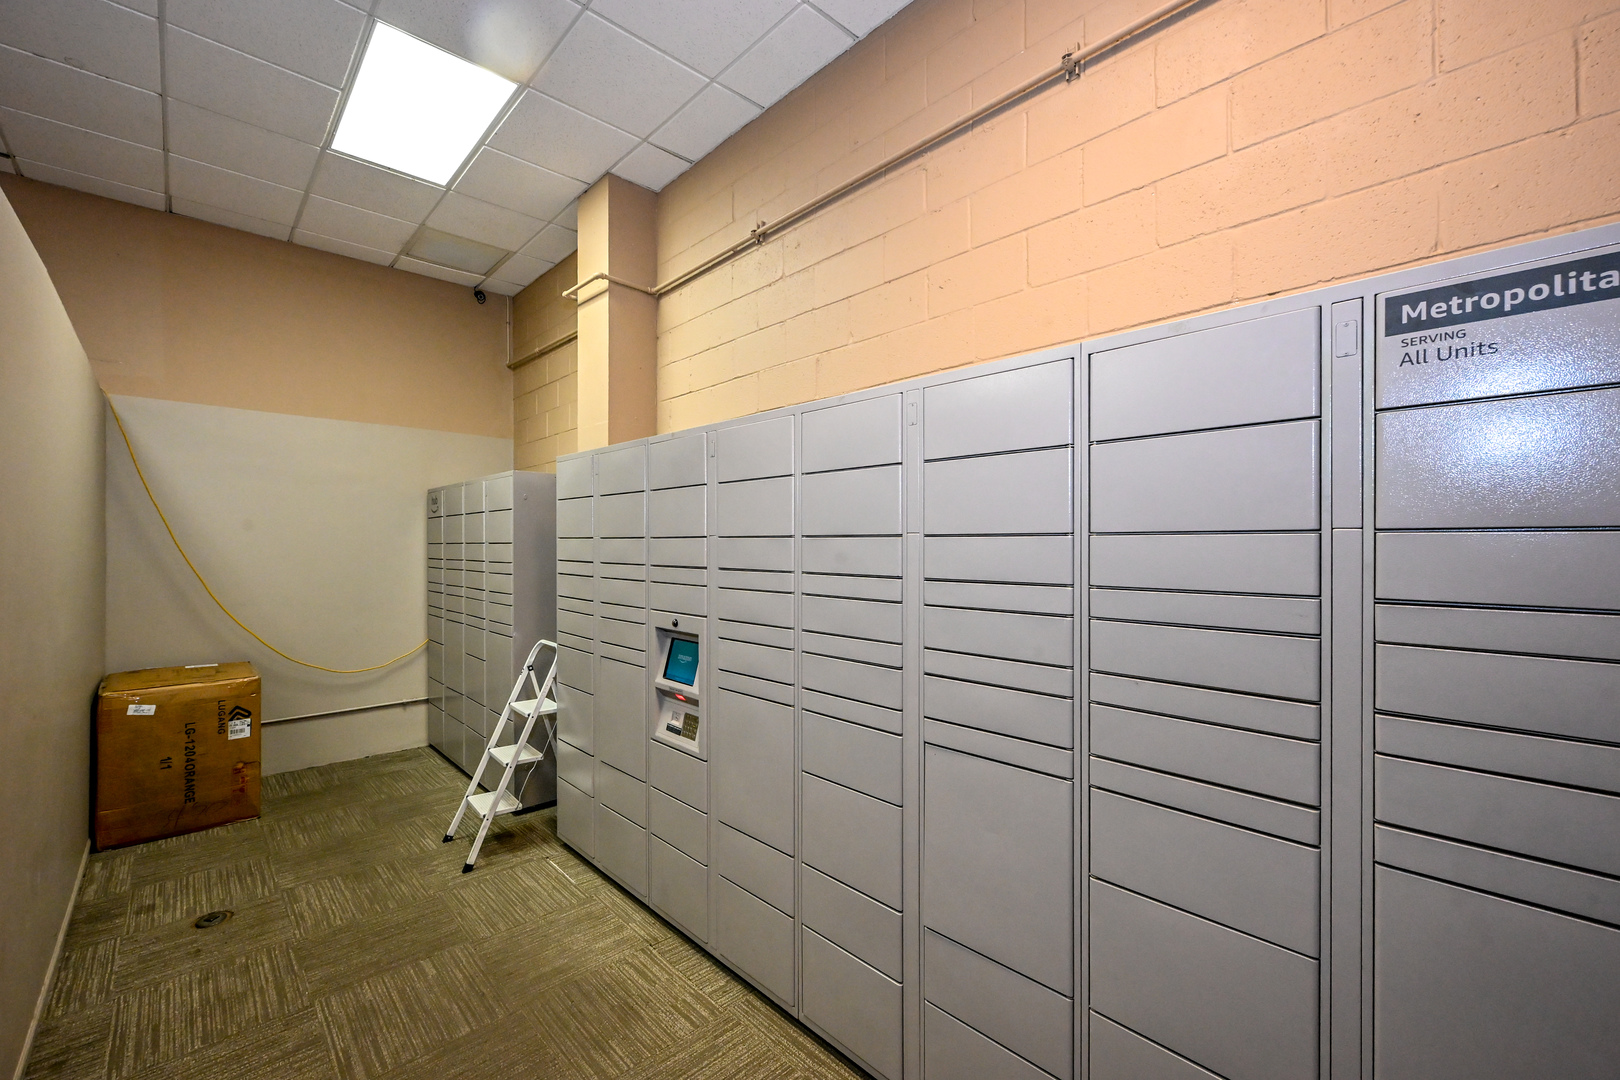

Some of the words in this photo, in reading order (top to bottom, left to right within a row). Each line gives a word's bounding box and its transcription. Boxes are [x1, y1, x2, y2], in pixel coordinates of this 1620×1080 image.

[1401, 269, 1620, 324] Metropolita
[1399, 348, 1428, 367] All
[1437, 341, 1499, 362] Units
[1400, 329, 1467, 348] SERVING
[217, 699, 226, 735] LUGANG
[184, 721, 196, 804] LG-1204ORANGE
